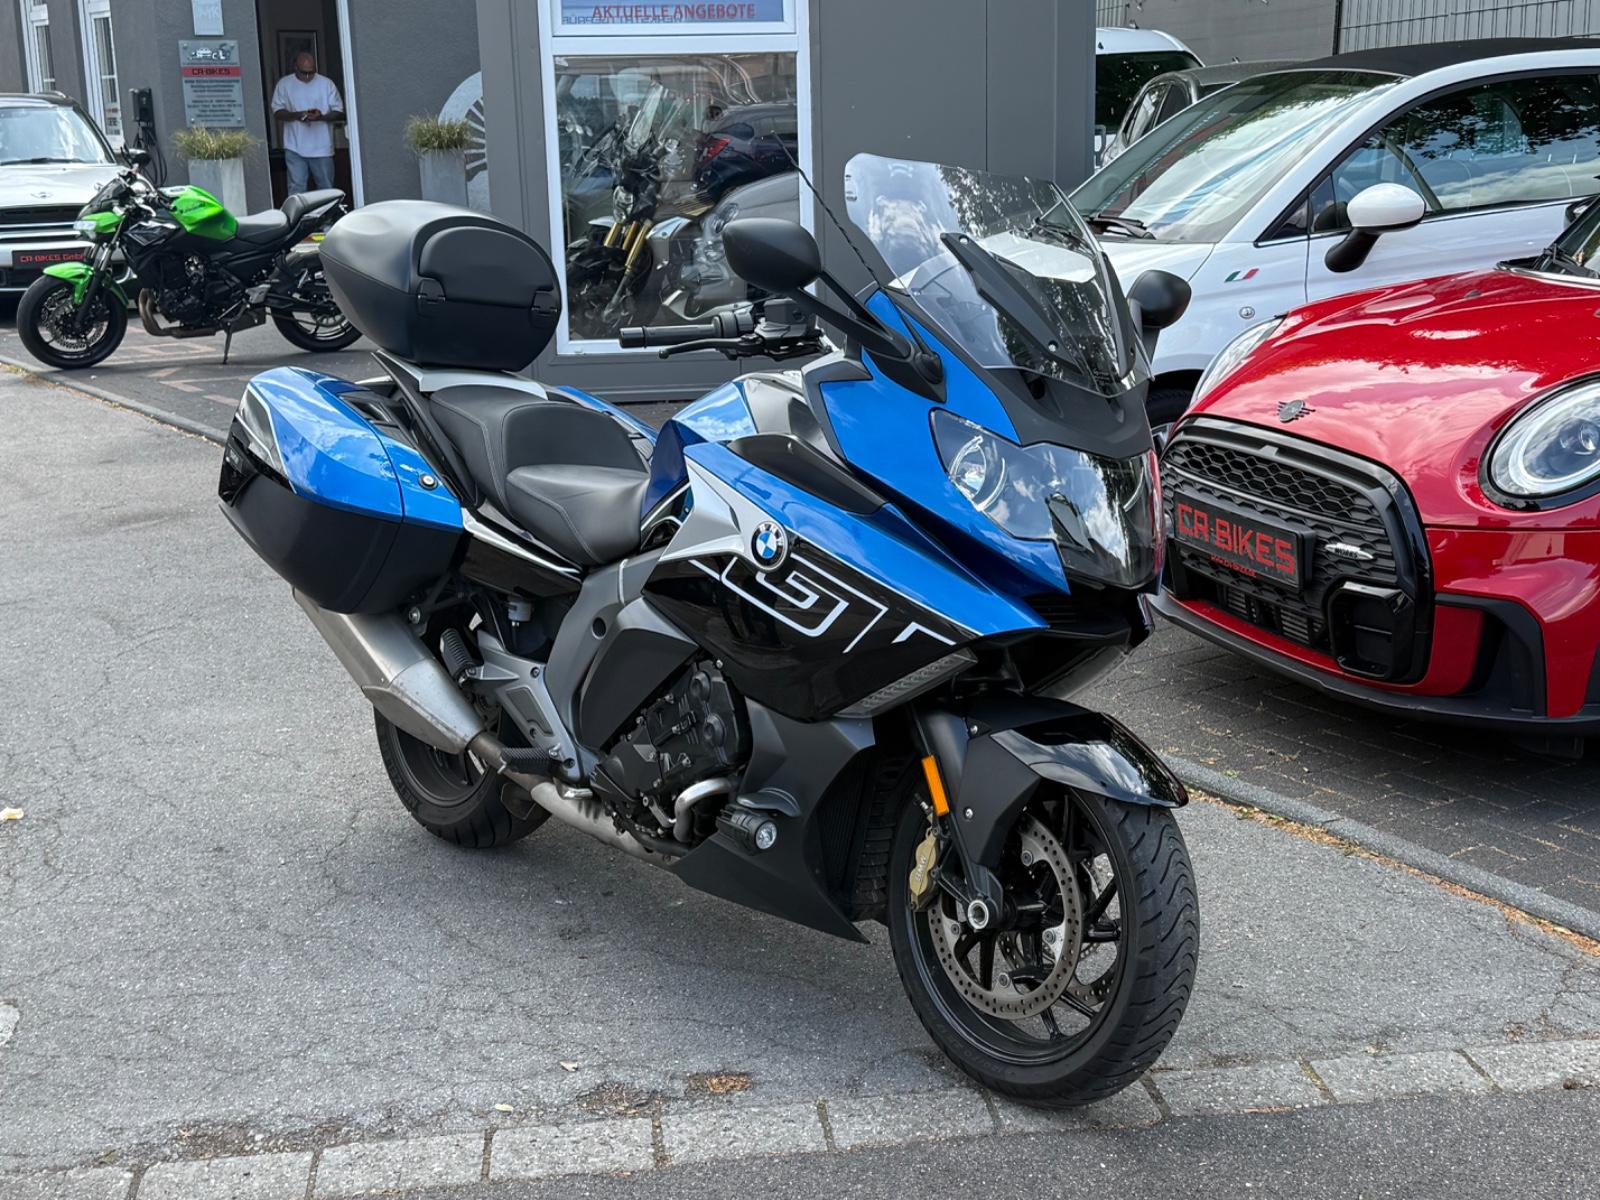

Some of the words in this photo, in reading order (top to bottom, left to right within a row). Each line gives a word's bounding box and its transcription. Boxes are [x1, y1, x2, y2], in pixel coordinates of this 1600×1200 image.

[592, 5, 669, 19] AKTUELLE
[673, 3, 756, 19] ANGEBOTE
[1178, 504, 1295, 574] CR-BIKES
